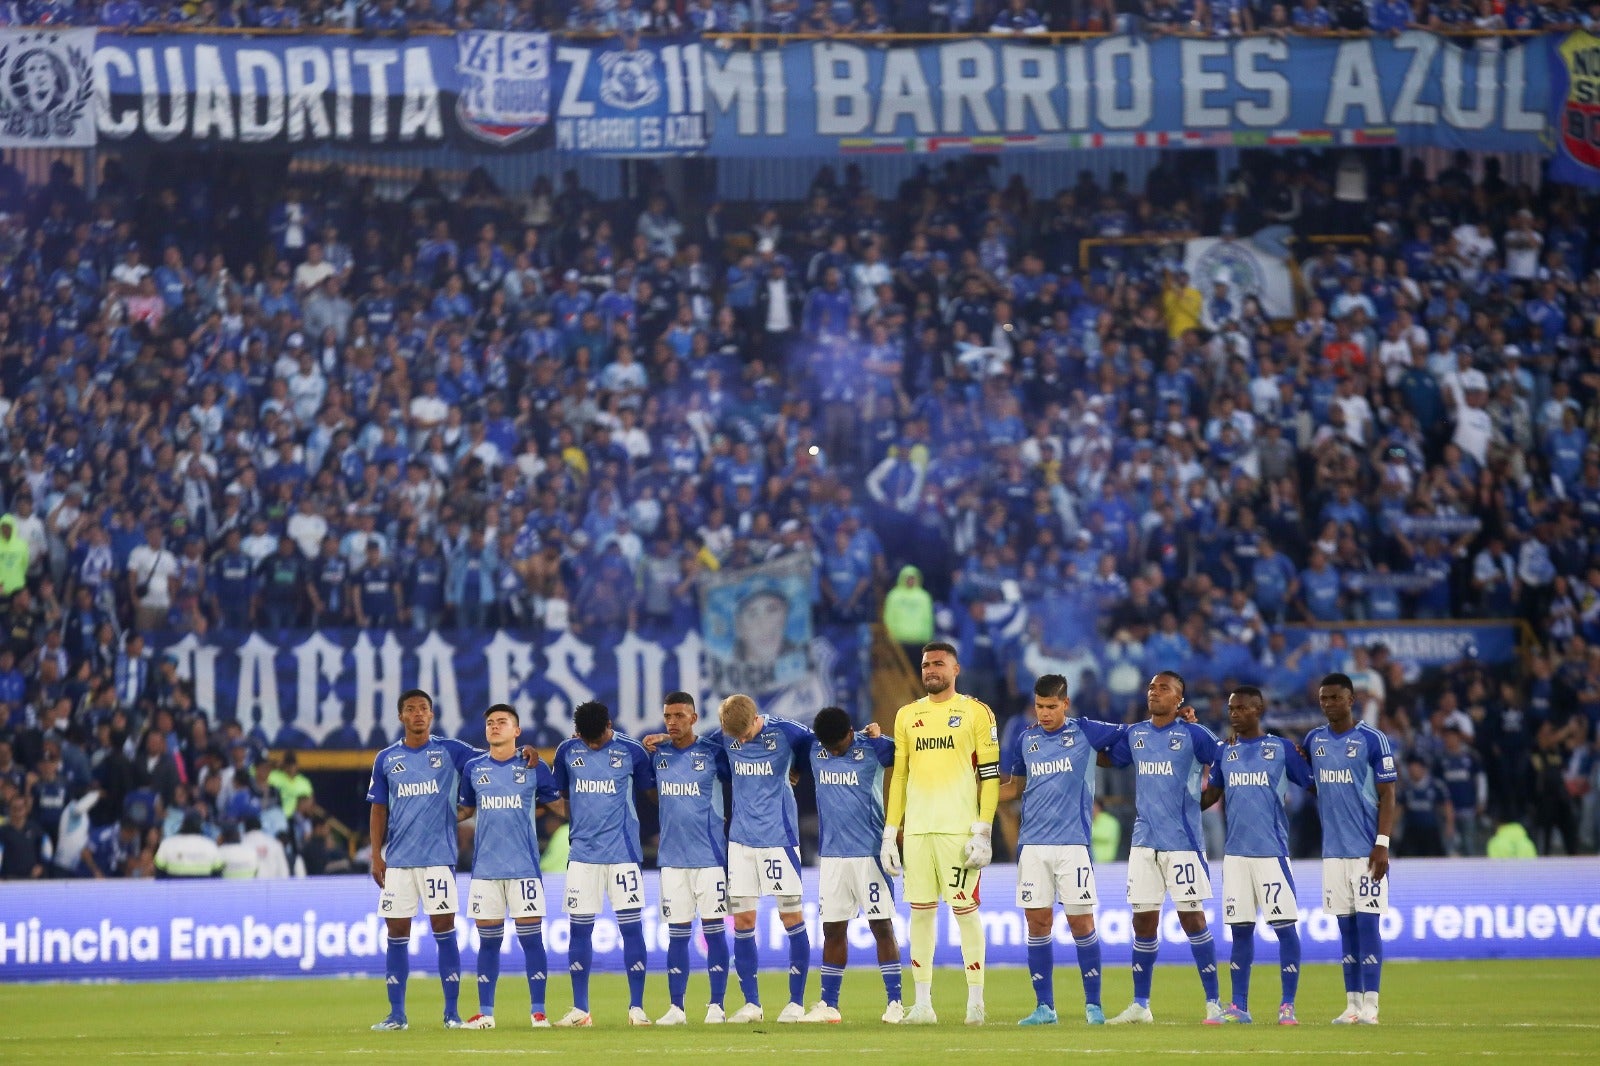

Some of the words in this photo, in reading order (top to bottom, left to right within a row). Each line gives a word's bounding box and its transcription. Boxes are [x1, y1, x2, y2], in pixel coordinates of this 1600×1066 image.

[555, 46, 596, 117] Z
[704, 50, 786, 135] MI
[813, 35, 1153, 135] BARRIO
[1181, 37, 1291, 127] ES
[1323, 30, 1548, 131] AZUL
[94, 44, 443, 142] CUADRITA
[914, 734, 955, 752] ANDINA
[734, 760, 774, 776] ANDINA
[819, 769, 860, 786] ANDINA
[1030, 757, 1073, 778] ANDINA
[1138, 760, 1173, 776] ANDINA
[397, 779, 440, 798] ANDINA
[575, 778, 616, 794] ANDINA
[661, 781, 700, 797] ANDINA
[1229, 771, 1270, 788] ANDINA
[481, 794, 522, 810] ANDINA
[764, 859, 782, 880] 26
[948, 866, 969, 890] 31
[1076, 866, 1090, 888] 17
[1173, 863, 1195, 885] 20
[426, 878, 448, 899] 34
[520, 880, 537, 900] 18
[616, 870, 638, 893] 43
[716, 881, 726, 902] 5
[1359, 875, 1381, 897] 88
[869, 882, 880, 903] 8
[1263, 882, 1282, 904] 77
[0, 916, 159, 964] Hincha
